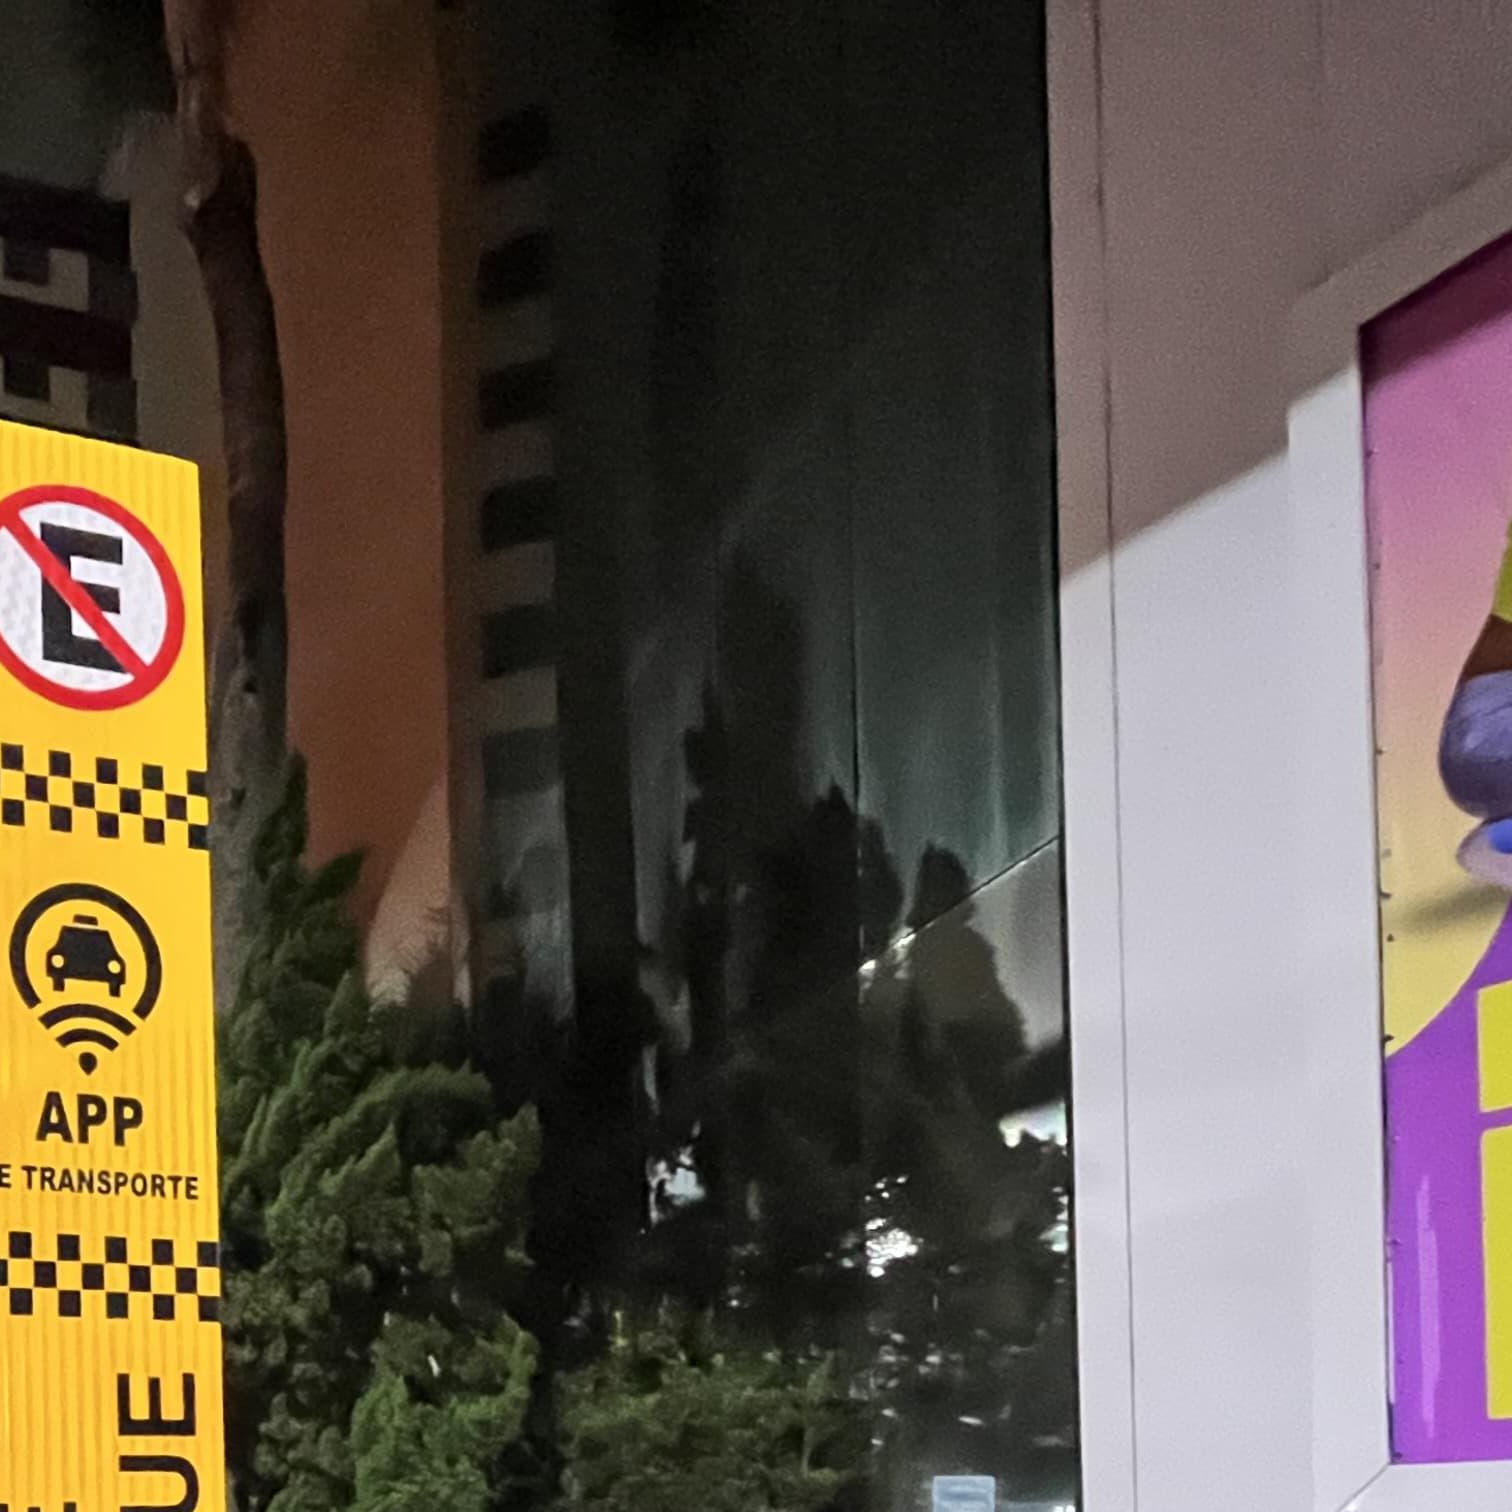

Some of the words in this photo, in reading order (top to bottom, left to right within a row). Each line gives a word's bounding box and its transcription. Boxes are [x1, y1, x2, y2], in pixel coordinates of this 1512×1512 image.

[39, 521, 125, 674] E
[36, 1090, 144, 1147] APP
[21, 1165, 199, 1201] TRANSPORTE
